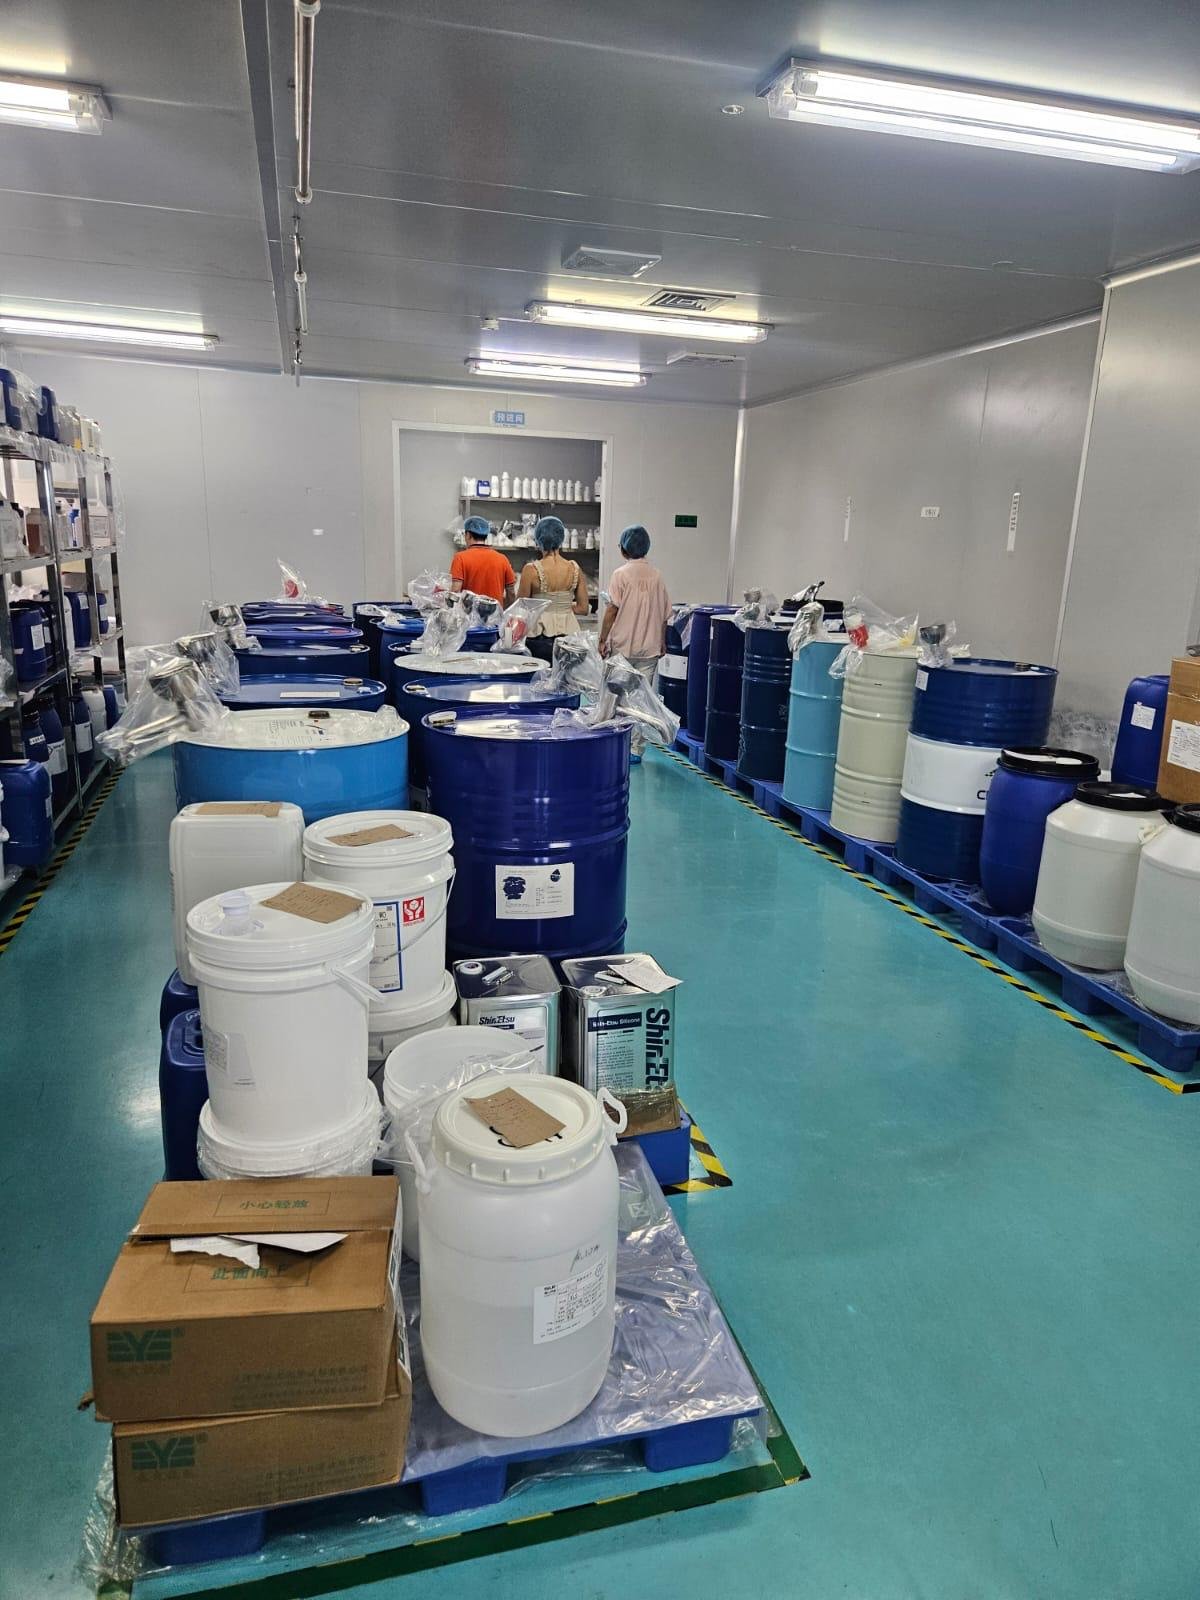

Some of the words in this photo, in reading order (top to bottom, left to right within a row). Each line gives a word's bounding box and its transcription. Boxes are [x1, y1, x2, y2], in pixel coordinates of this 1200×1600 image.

[239, 1199, 310, 1210] 小心轻放
[211, 1264, 287, 1281] 此面向上
